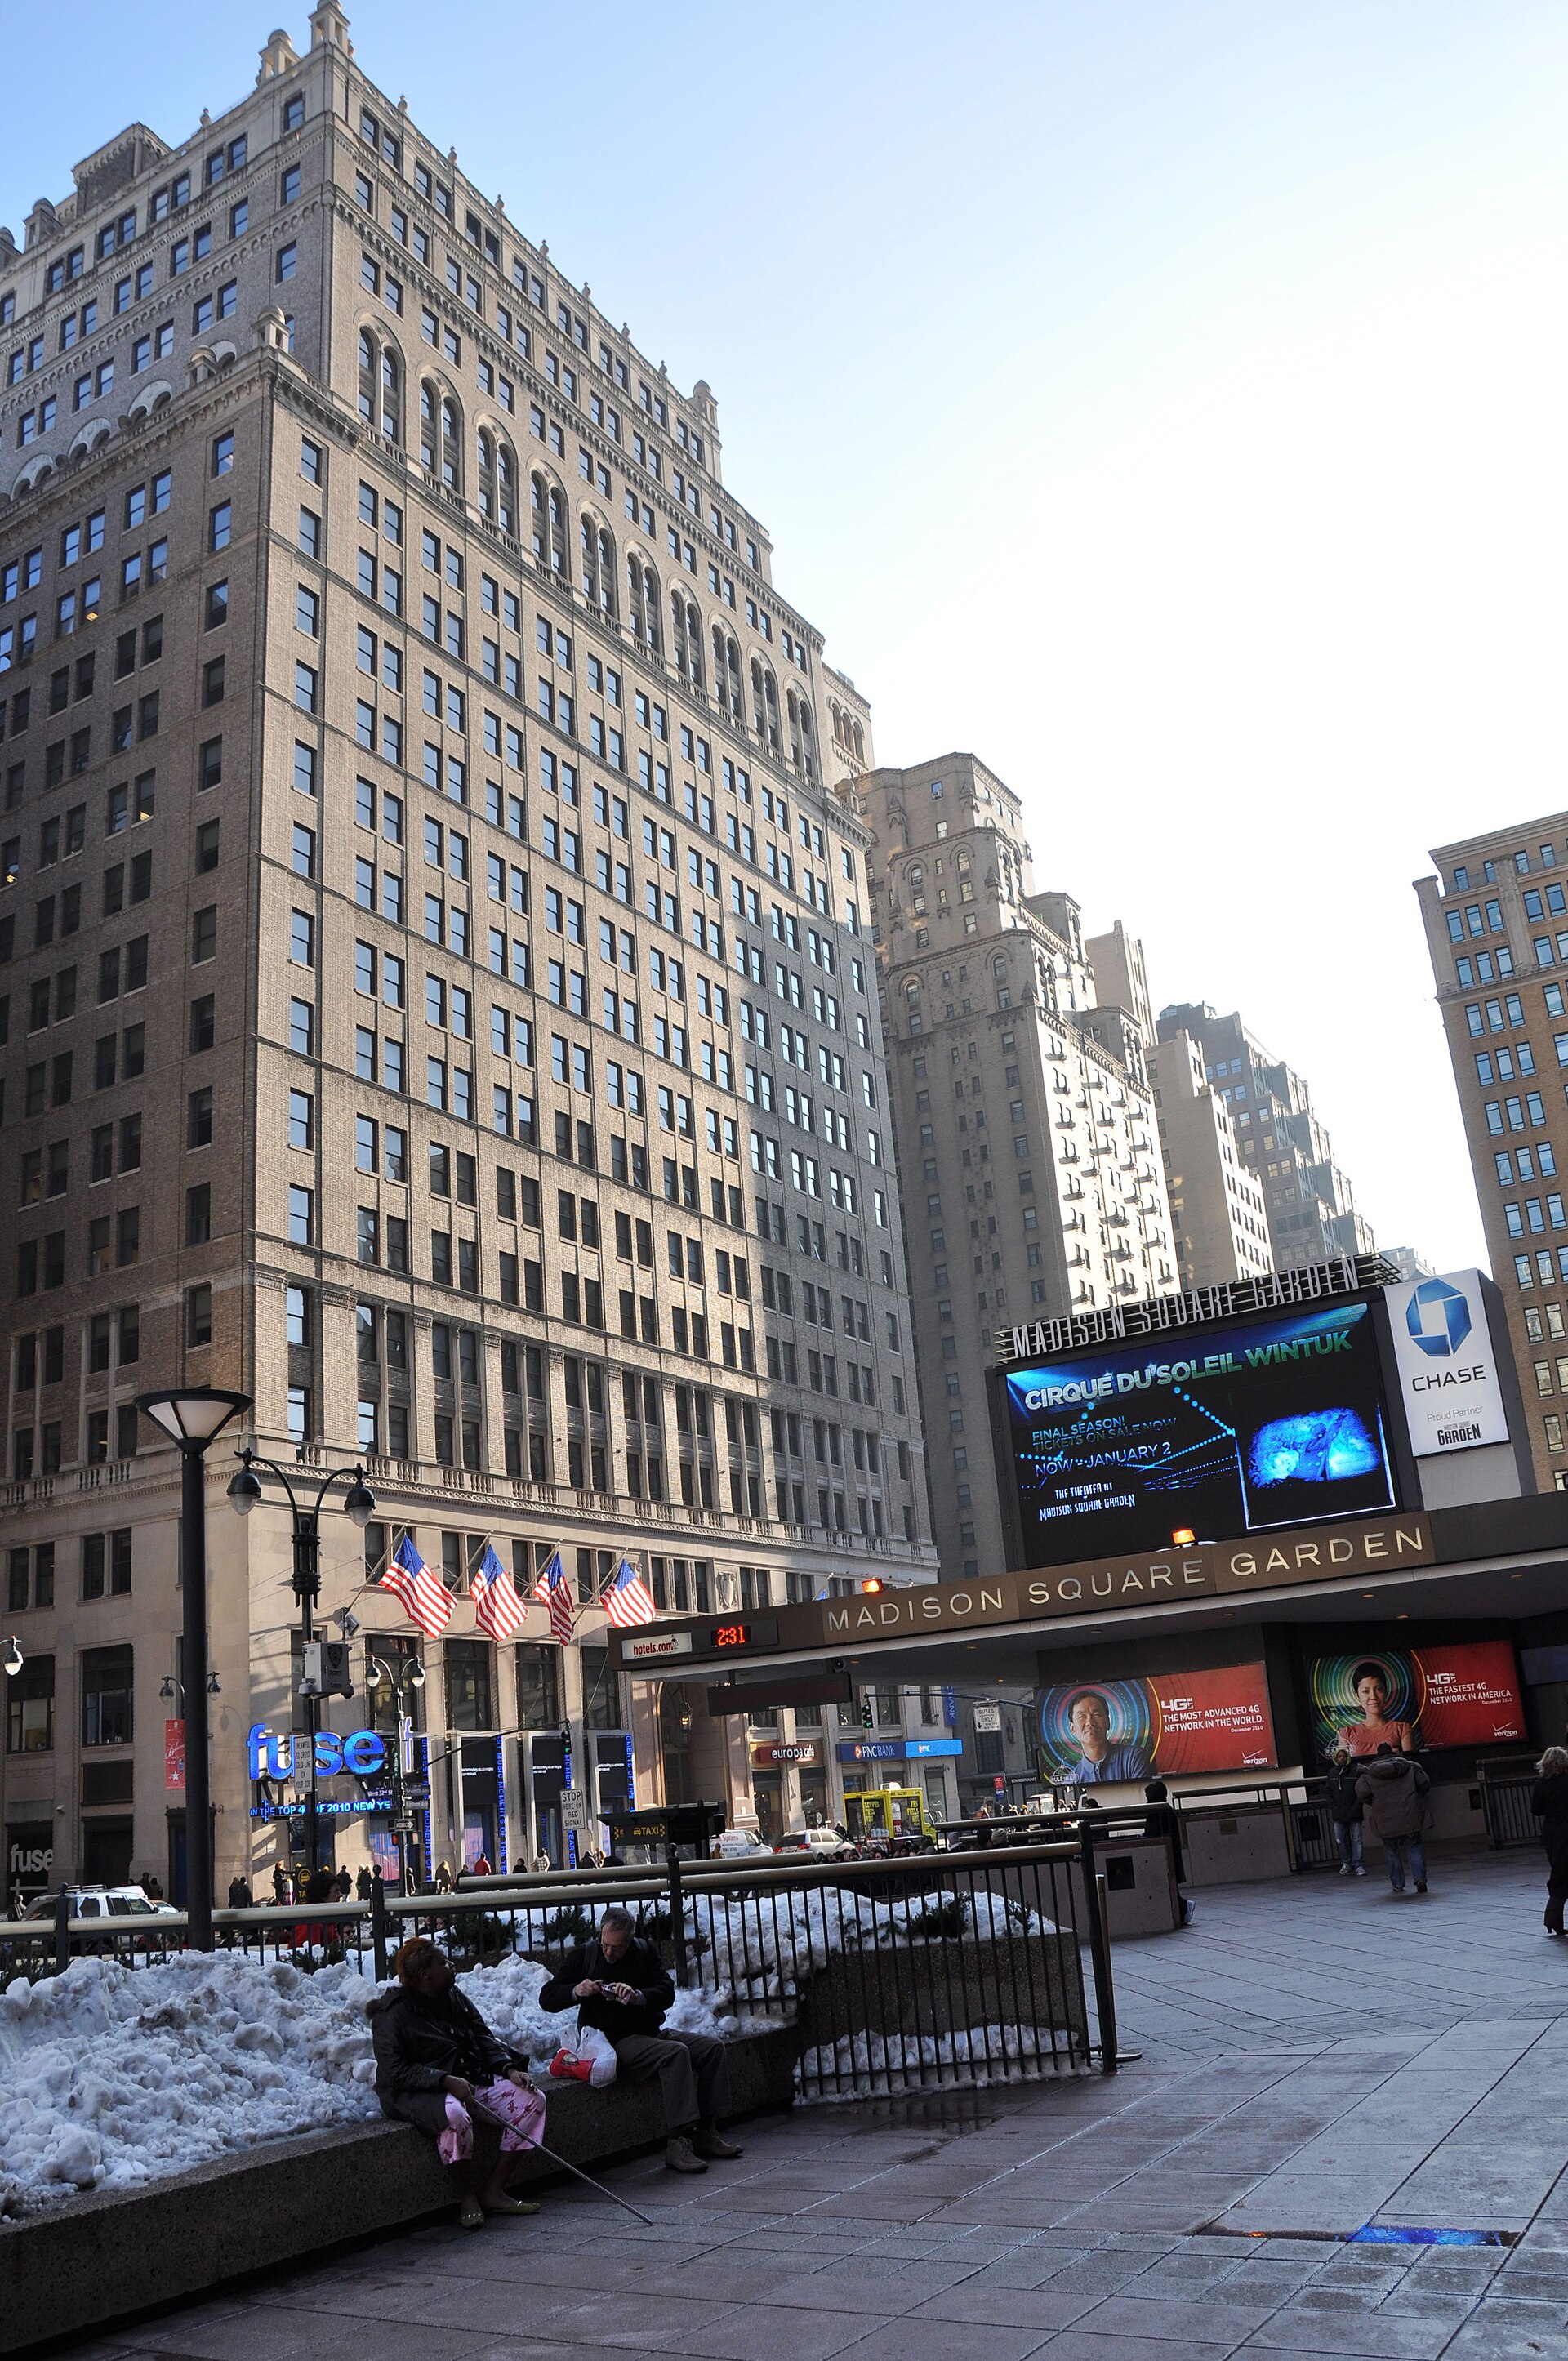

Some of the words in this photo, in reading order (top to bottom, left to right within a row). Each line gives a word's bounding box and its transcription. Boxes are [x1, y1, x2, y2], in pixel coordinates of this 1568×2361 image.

[1012, 1306, 1126, 1359] MADISON
[1139, 1281, 1239, 1333] SQUARE
[1252, 1255, 1360, 1308] GARDEN
[1025, 1374, 1114, 1410] CIRQUE
[1156, 1352, 1242, 1385] SOLEIL
[1244, 1329, 1352, 1369] WINTUK
[1412, 1365, 1486, 1392] CHASE
[1426, 1411, 1451, 1423] Proud
[1452, 1405, 1483, 1418] Partner
[1031, 1426, 1068, 1442] FINAL
[1070, 1414, 1125, 1435] SEASON!
[1437, 1423, 1481, 1446] GARDEN
[1032, 1436, 1084, 1453] TICKETS
[1086, 1430, 1105, 1443] ON
[1035, 1458, 1073, 1477] NOW
[1086, 1443, 1159, 1468] JANUARY
[1161, 1441, 1172, 1454] 2
[828, 1587, 1004, 1633] MADISON
[1027, 1558, 1206, 1606] SQUARE
[1229, 1526, 1424, 1576] GARDEN
[716, 1624, 746, 1646] 2:31
[633, 1643, 674, 1656] hotels.com
[1426, 1673, 1450, 1685] 4G
[1428, 1686, 1443, 1695] THE
[1444, 1683, 1475, 1695] FASTEST
[1476, 1682, 1487, 1690] 4G
[1429, 1694, 1468, 1705] NETWORK
[1468, 1692, 1477, 1700] IN
[1477, 1690, 1513, 1700] AMERICA.
[1160, 1698, 1187, 1712] 4G
[1163, 1713, 1178, 1723] THE
[1179, 1711, 1202, 1721] MOST
[1204, 1705, 1247, 1718] ADVANCED
[1248, 1704, 1260, 1713] 4G
[1164, 1721, 1205, 1733] NETWORK
[1205, 1720, 1214, 1728] IN
[1215, 1718, 1232, 1727] THE
[1232, 1715, 1265, 1726] WORLD.
[1494, 1729, 1517, 1737] verizon
[247, 1722, 385, 1780] fuse
[771, 1748, 804, 1762] europa
[1242, 1757, 1267, 1765] verizon
[497, 1780, 506, 1824] MOMENTS
[562, 1792, 581, 1802] STOP
[278, 1805, 295, 1815] TOP
[327, 1802, 350, 1813] 2010
[353, 1800, 375, 1811] NEW
[500, 1825, 506, 1838] OF
[564, 1819, 582, 1827] SIGNAL
[641, 1826, 659, 1836] TAXI
[424, 1810, 432, 1856] MOMENTS
[11, 1843, 53, 1873] fuse
